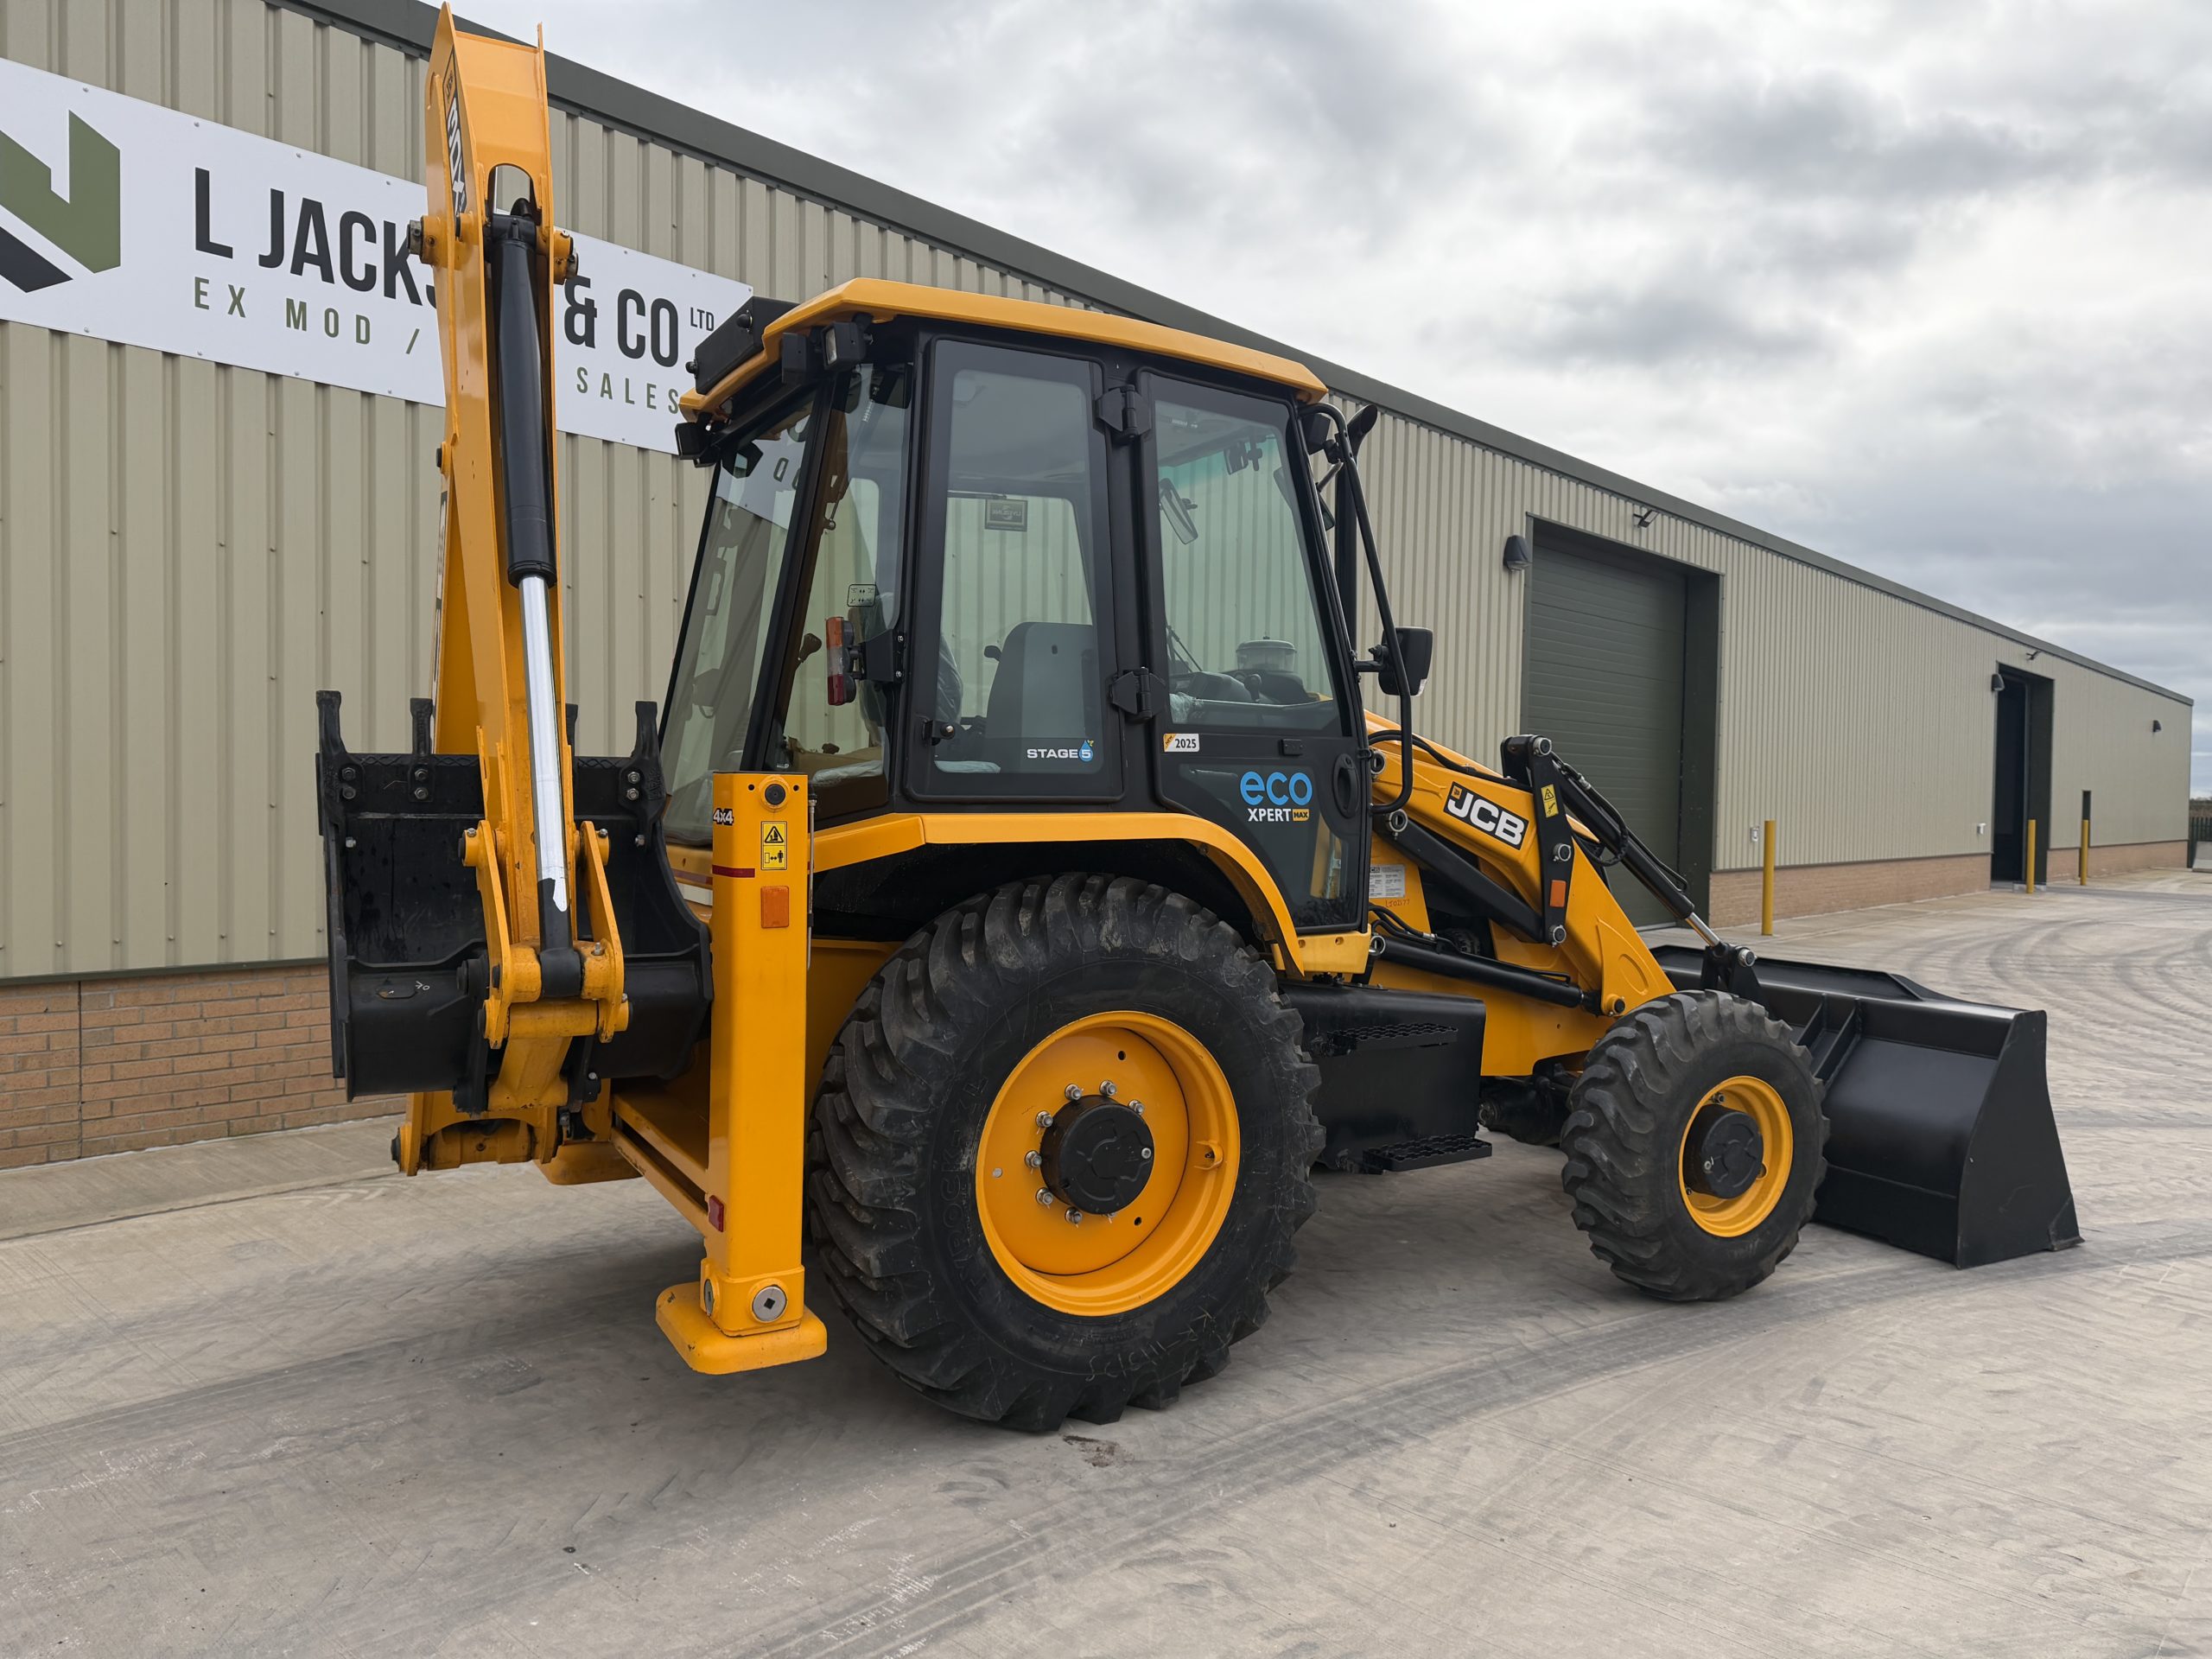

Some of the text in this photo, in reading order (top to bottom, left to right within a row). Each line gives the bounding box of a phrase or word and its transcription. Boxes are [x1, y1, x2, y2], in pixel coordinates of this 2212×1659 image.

[194, 167, 715, 367] L JACK & CO LTD
[194, 276, 246, 318] EX
[285, 297, 371, 345] MOD
[576, 366, 679, 415] SALES
[1027, 748, 1091, 759] STAGE 5
[1175, 739, 1197, 749] 2025
[1240, 771, 1313, 805] eco
[1247, 808, 1291, 822] XPERT
[1447, 792, 1525, 845] JCB
